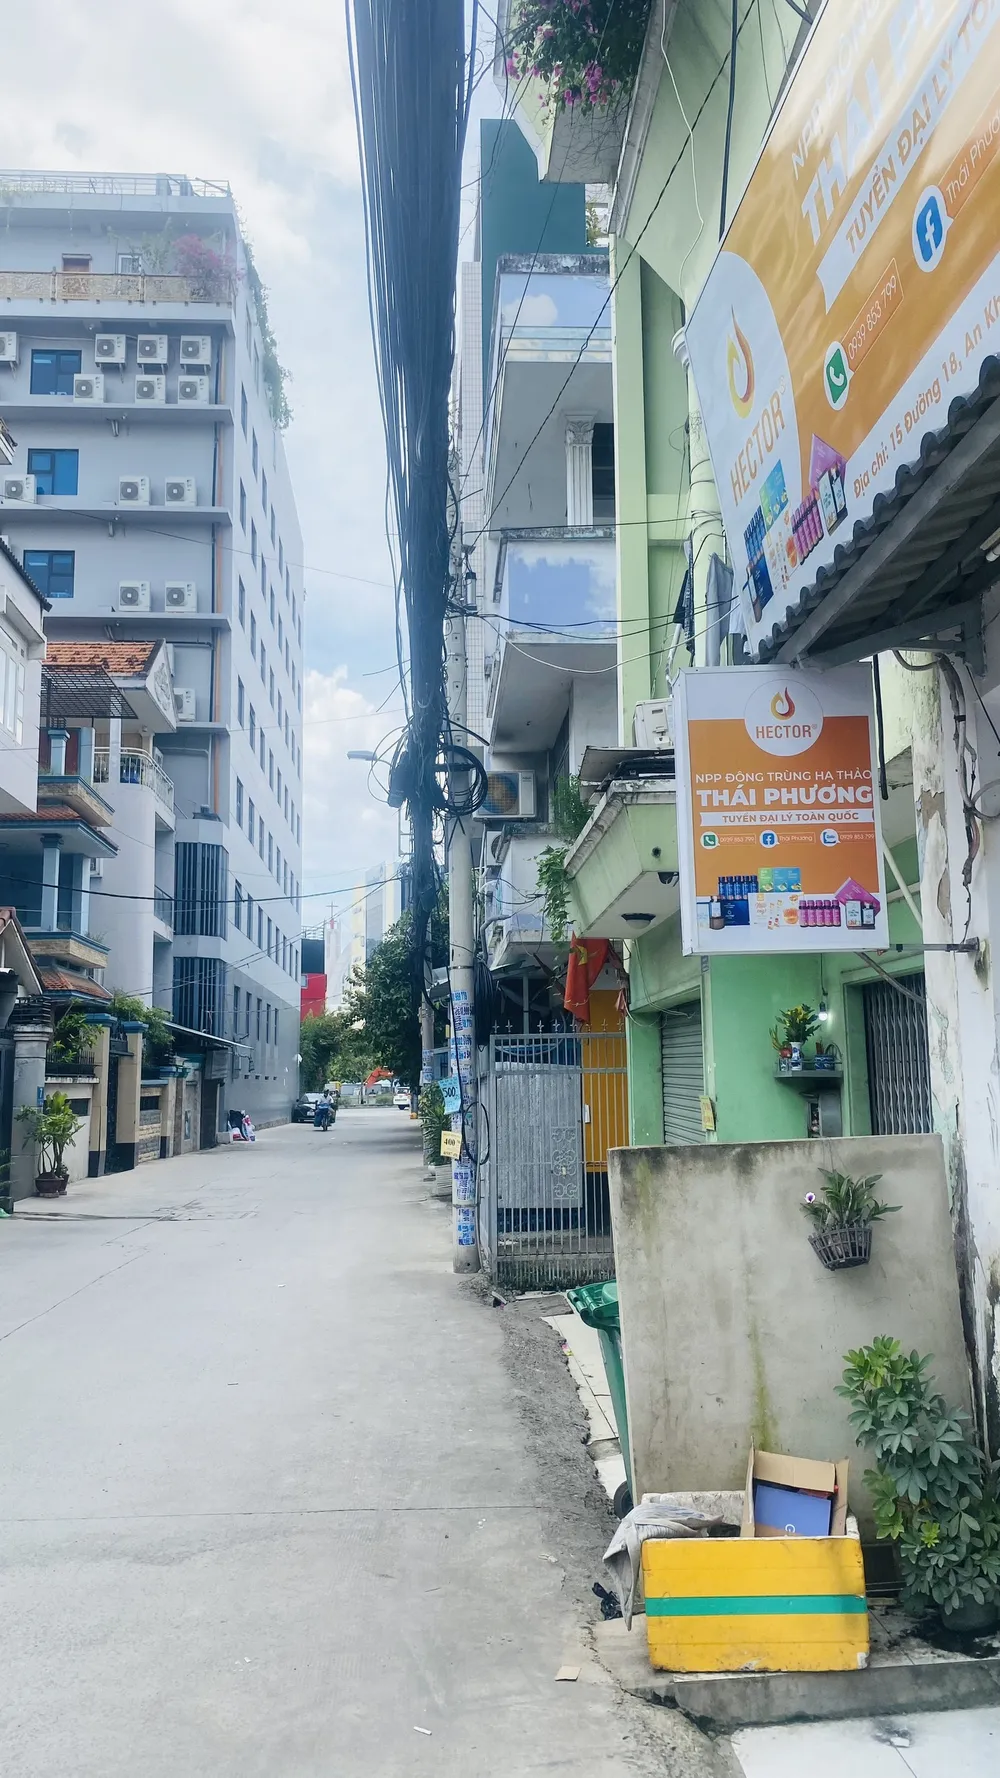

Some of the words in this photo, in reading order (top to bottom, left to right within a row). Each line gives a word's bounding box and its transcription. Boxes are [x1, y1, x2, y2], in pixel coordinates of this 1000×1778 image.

[846, 153, 898, 253] TUYỂN
[896, 93, 932, 165] ĐẠI
[957, 0, 997, 53] TO
[946, 158, 970, 204] Thái
[848, 323, 866, 361] 0939
[866, 300, 882, 333] 853
[880, 275, 897, 310] 799
[853, 472, 870, 498] Địa
[889, 422, 904, 451] 15
[904, 376, 942, 431] Đường
[941, 351, 962, 383] 18,
[965, 323, 983, 358] An
[730, 391, 786, 507] HECTOR
[755, 725, 812, 739] HECTOR
[696, 773, 722, 783] NPP
[725, 770, 764, 783] ĐÔNG
[767, 769, 811, 782] TRÙNG
[815, 770, 834, 782] HẠ
[836, 766, 872, 780] THẢO
[696, 783, 756, 807] THÁI
[764, 783, 872, 805] PHƯƠNG
[759, 813, 779, 824] ĐẠI
[781, 811, 793, 822] LÝ
[796, 811, 825, 822] TOÀN
[827, 809, 859, 822] QUỐC
